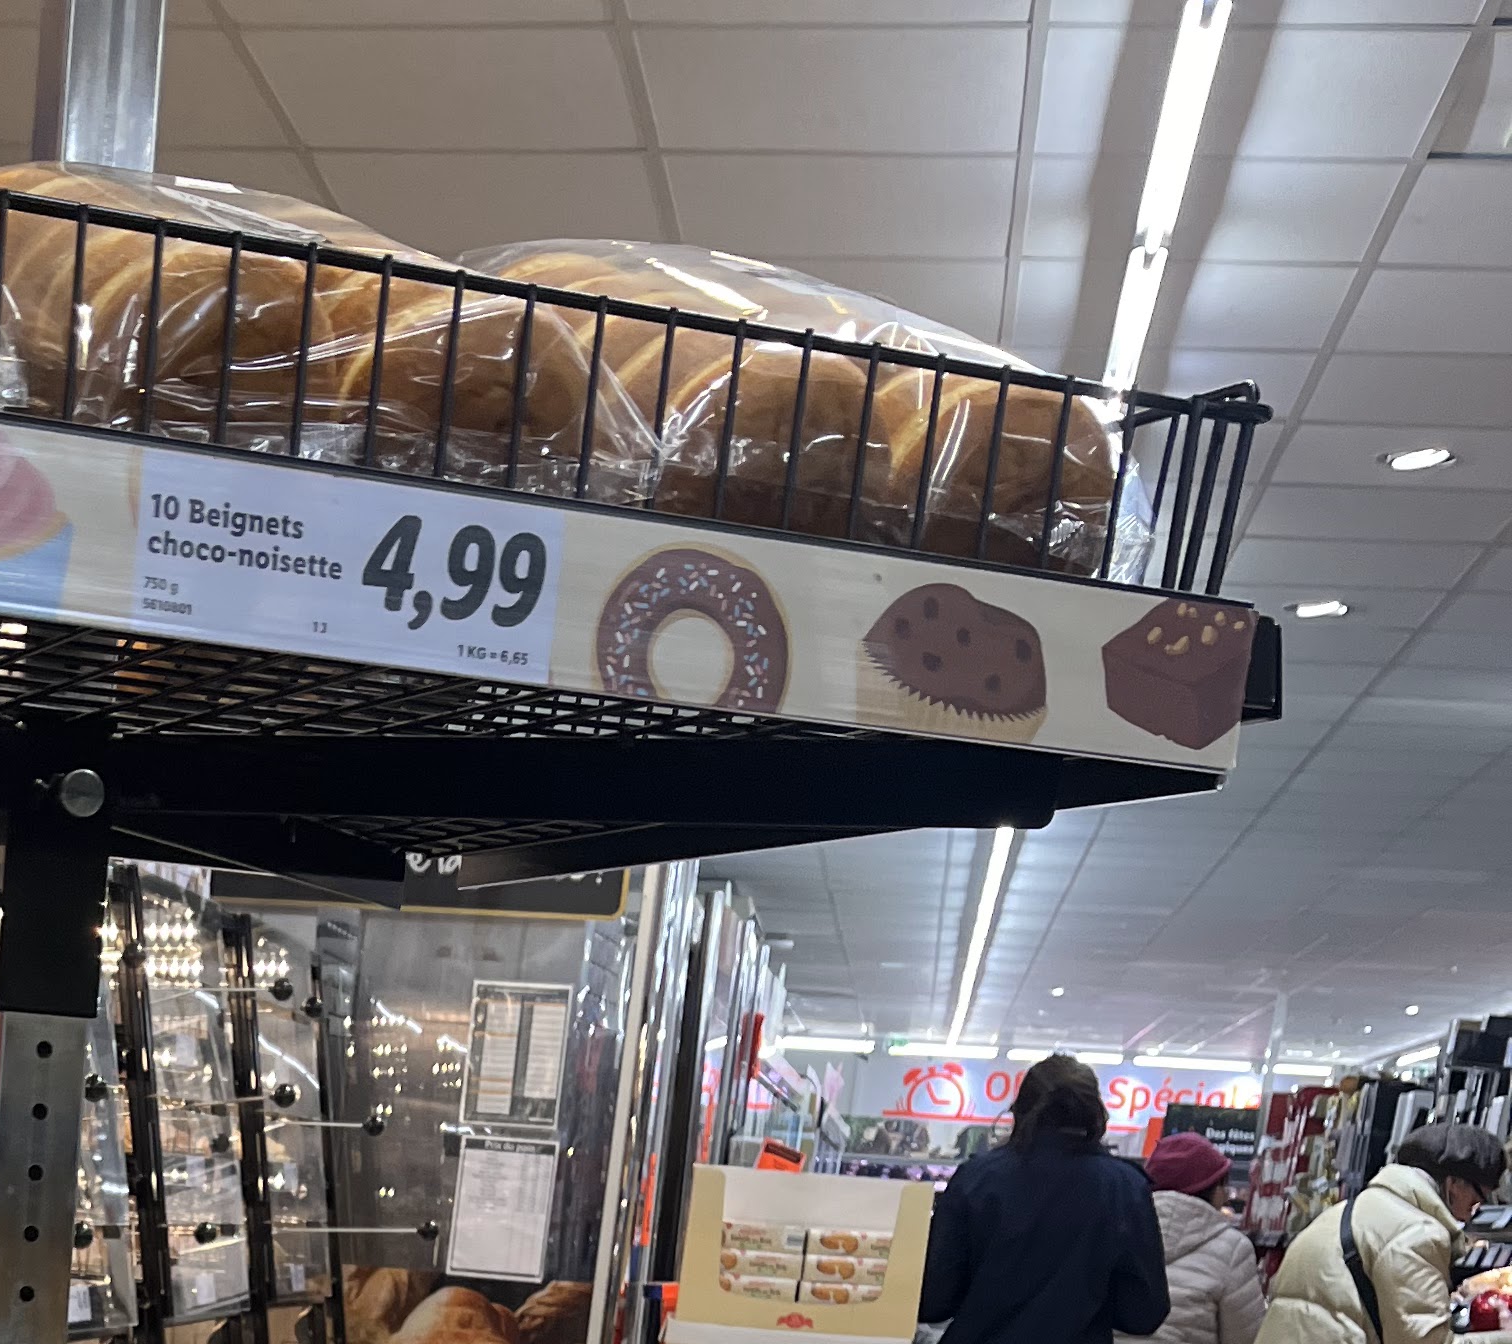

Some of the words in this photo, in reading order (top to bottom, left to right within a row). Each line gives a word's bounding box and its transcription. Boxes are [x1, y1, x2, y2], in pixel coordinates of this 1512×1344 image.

[150, 493, 179, 520] 10
[188, 498, 304, 539] Beignets
[147, 531, 343, 580] choco-noisette
[362, 514, 548, 630] 4,99
[467, 646, 487, 659] KG
